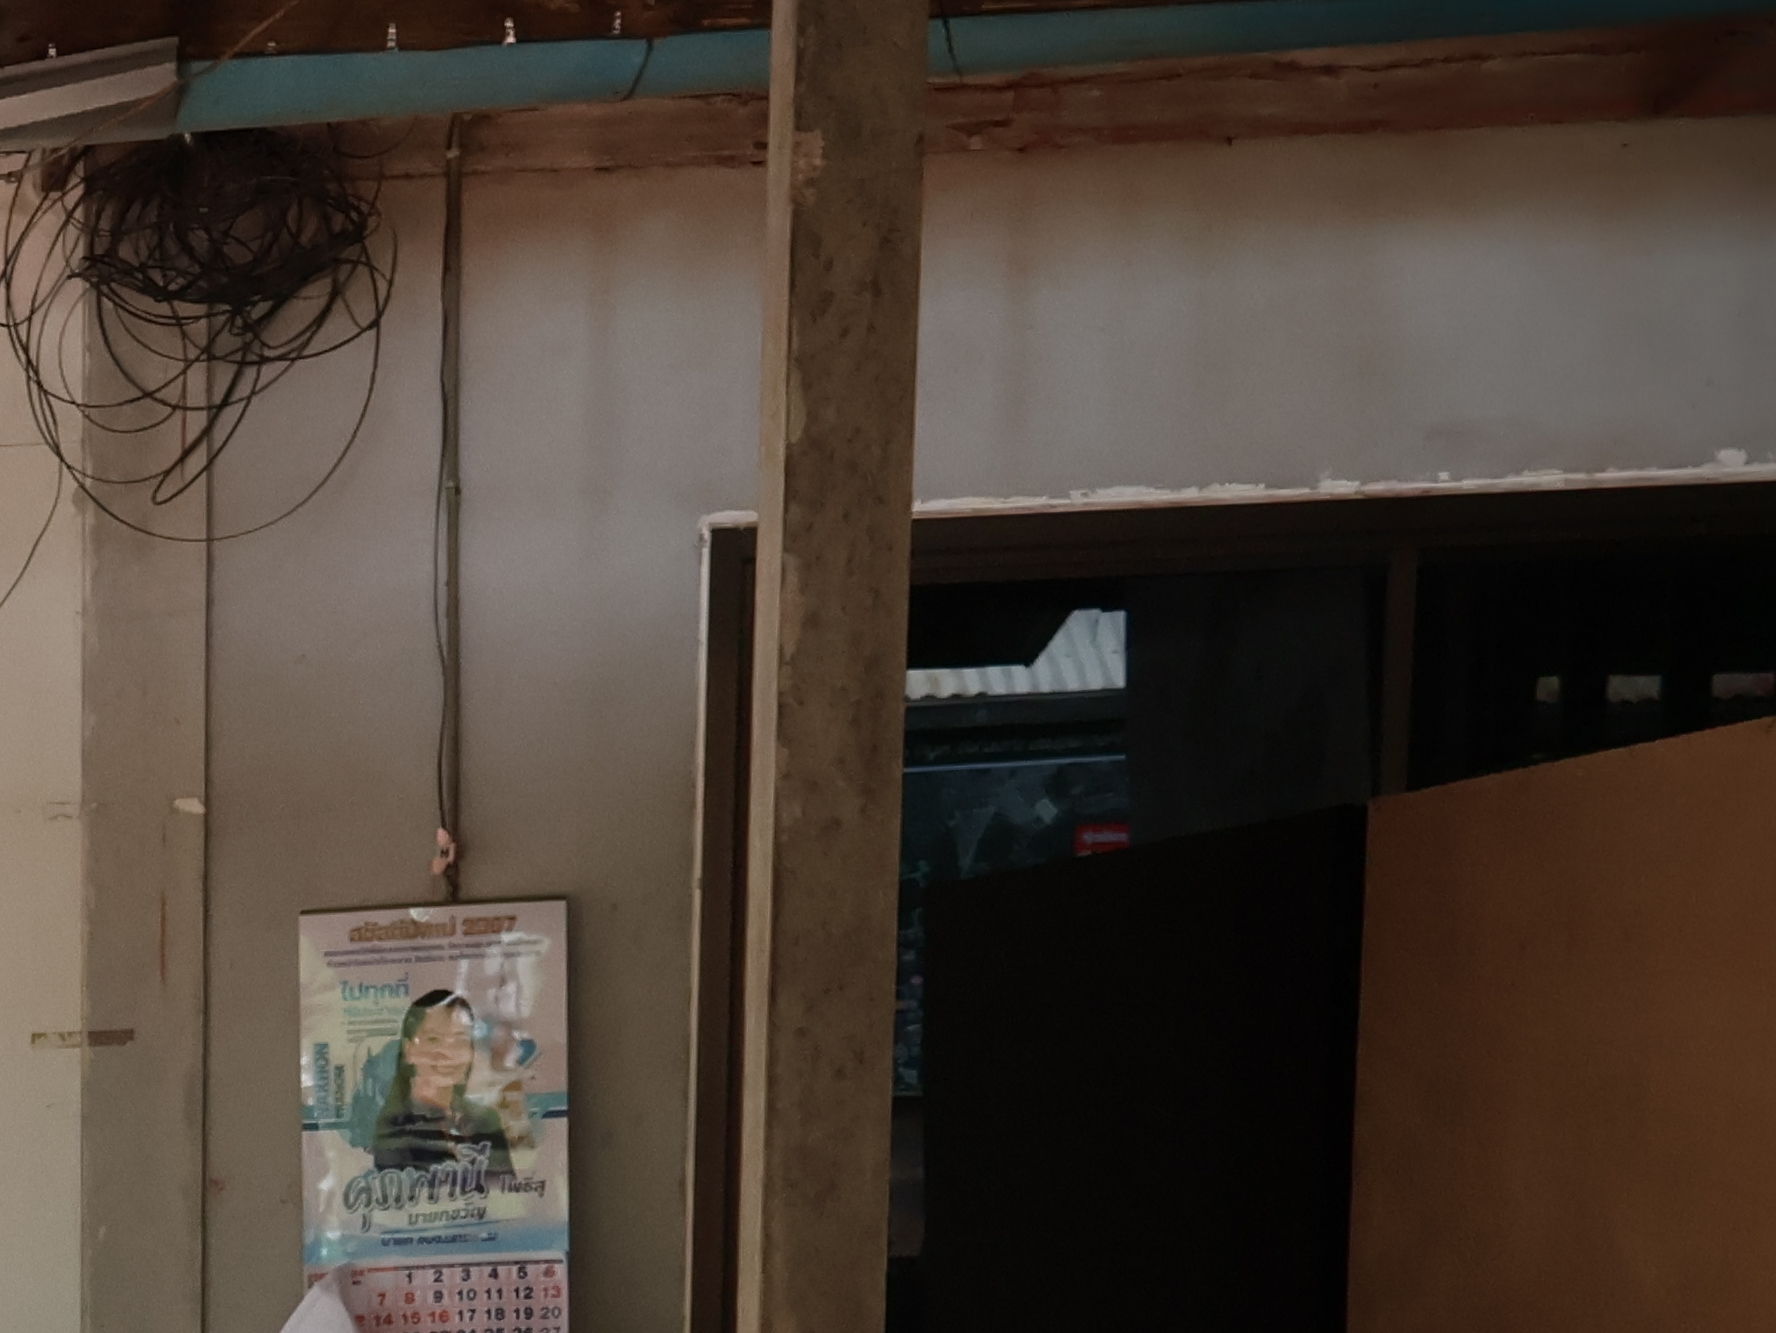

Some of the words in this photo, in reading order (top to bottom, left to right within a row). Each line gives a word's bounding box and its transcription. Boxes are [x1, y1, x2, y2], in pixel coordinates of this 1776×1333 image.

[406, 1271, 414, 1284] 1
[433, 1269, 444, 1283] 2
[461, 1268, 471, 1282] 3
[488, 1267, 498, 1280] 4
[517, 1265, 528, 1280] 5
[377, 1293, 387, 1306] 7
[433, 1289, 444, 1303] 9
[456, 1288, 477, 1302] 10
[485, 1286, 503, 1300] 11
[513, 1286, 534, 1300] 12
[542, 1284, 562, 1299] 13
[373, 1314, 394, 1329] 14
[401, 1312, 421, 1326] 15
[428, 1310, 449, 1324] 16
[457, 1308, 477, 1322] 17
[485, 1307, 505, 1321] 18
[513, 1306, 534, 1320] 19
[539, 1305, 561, 1320] 20
